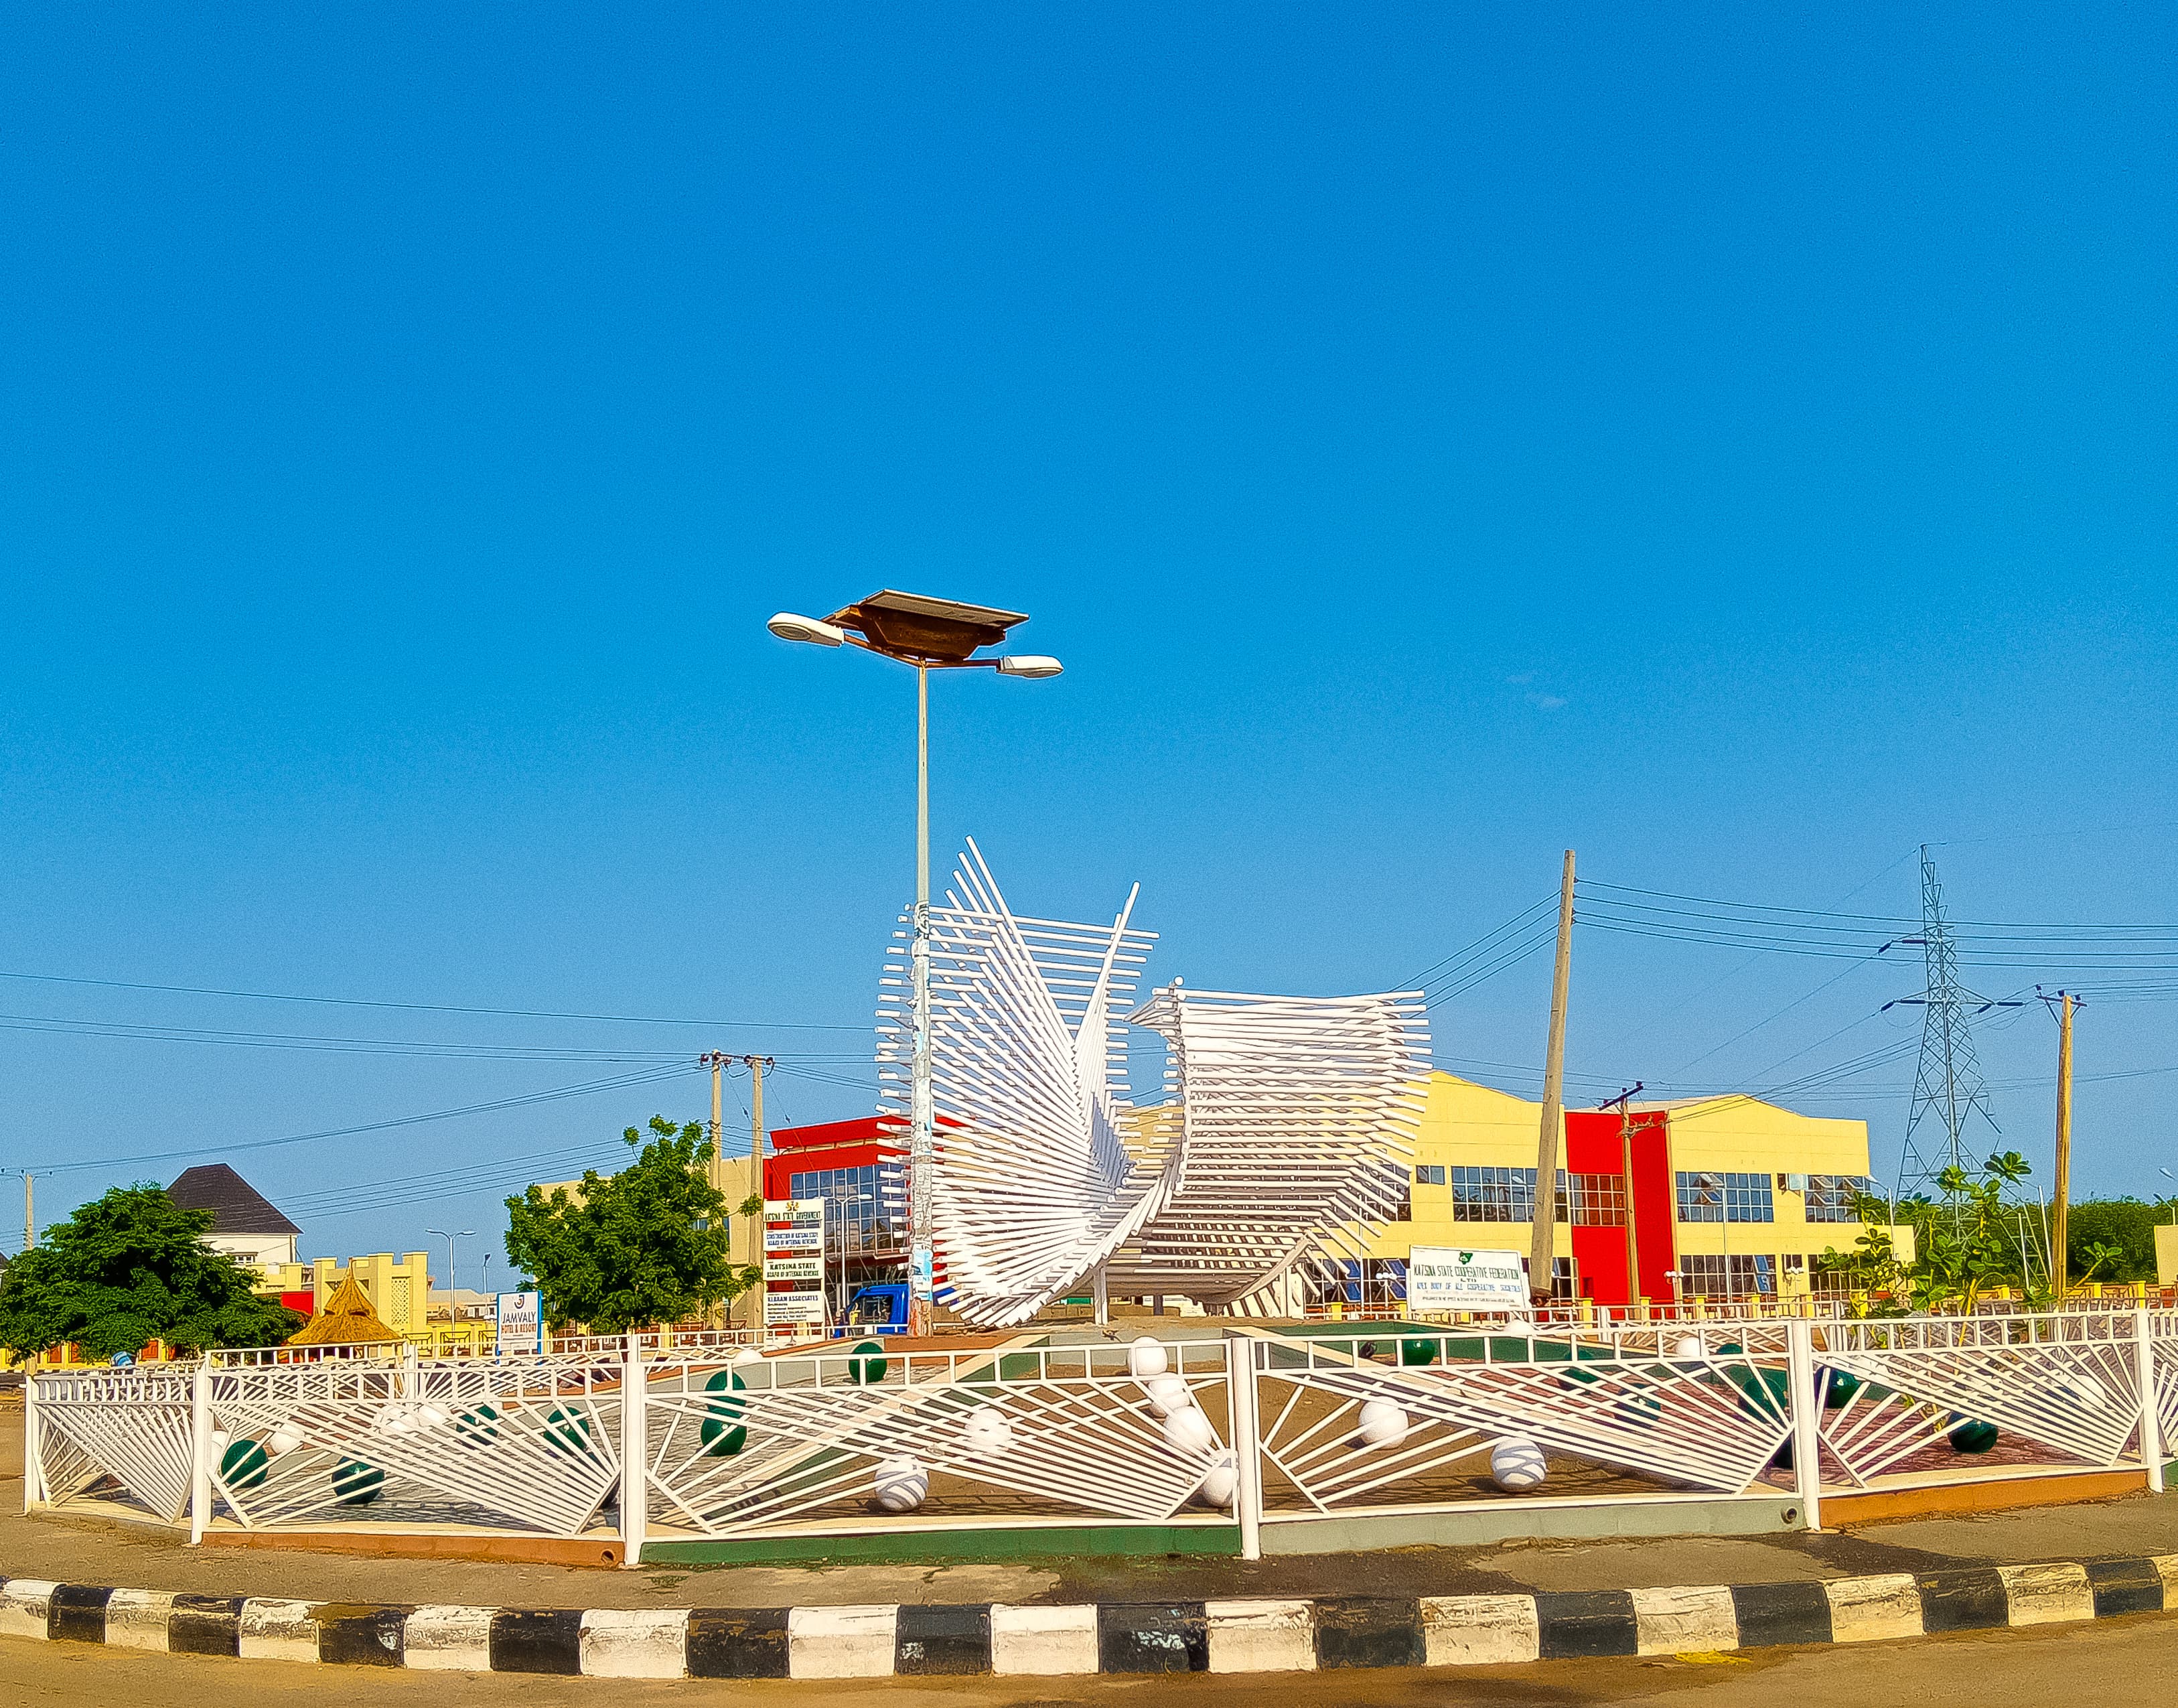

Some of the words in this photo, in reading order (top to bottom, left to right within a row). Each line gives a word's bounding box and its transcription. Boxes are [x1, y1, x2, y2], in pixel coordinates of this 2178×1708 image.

[1414, 1265, 1436, 1277] KATSINA
[1437, 1265, 1453, 1277] STATE
[1455, 1266, 1488, 1279] COOPERATIVE
[1489, 1267, 1519, 1280] FEDERATION
[502, 1311, 536, 1324] JAMVALY
[501, 1324, 514, 1334] HOTEL
[520, 1324, 536, 1332] RESORT
